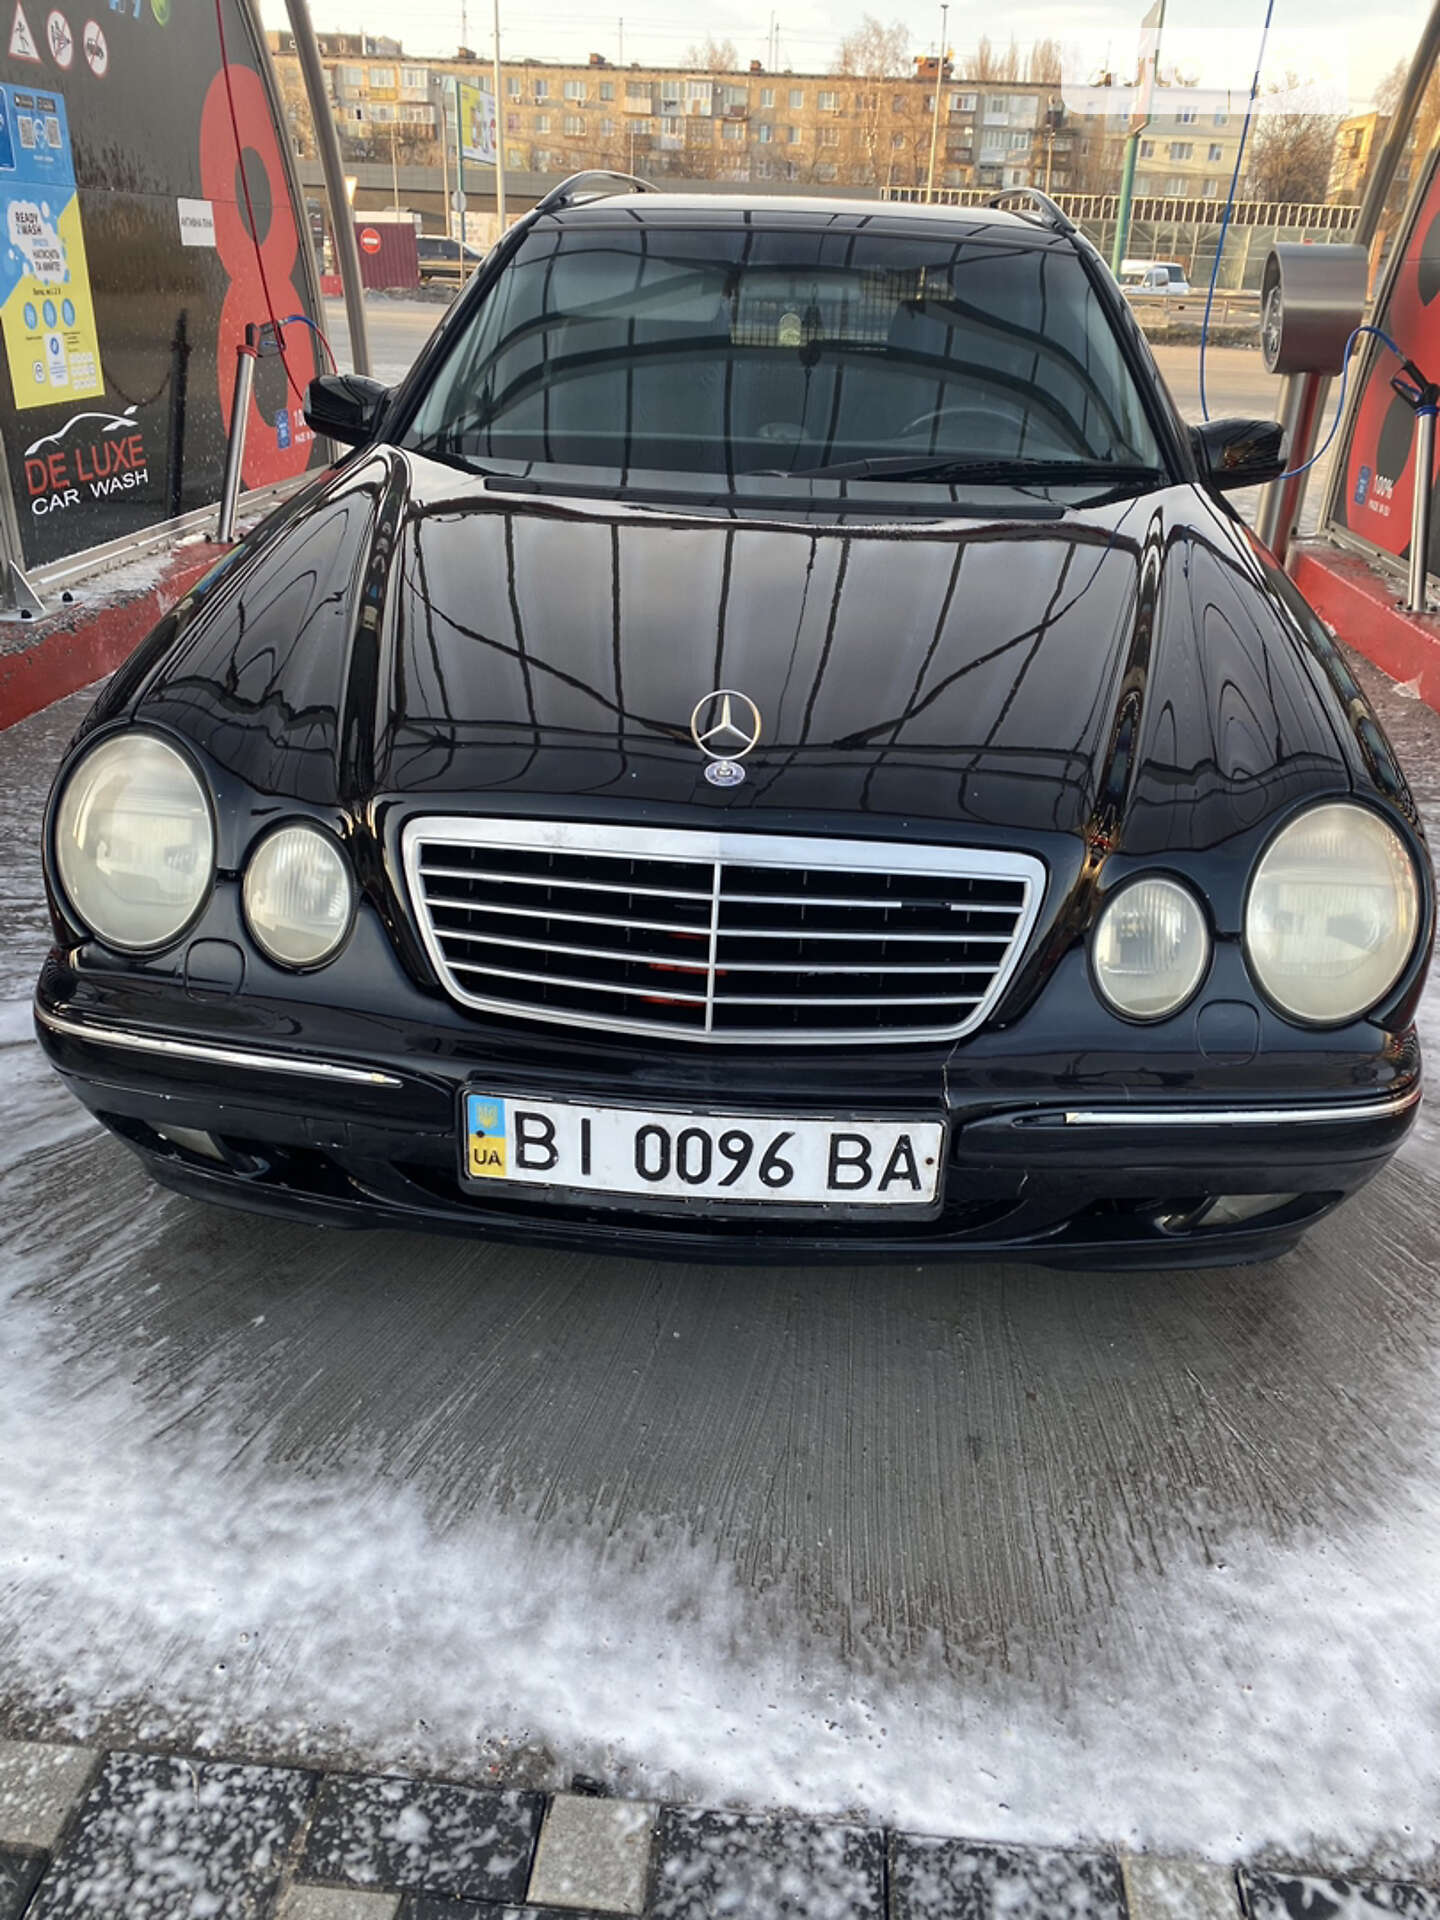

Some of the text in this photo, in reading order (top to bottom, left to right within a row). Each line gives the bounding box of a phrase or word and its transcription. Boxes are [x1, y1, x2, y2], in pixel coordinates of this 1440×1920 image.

[24, 434, 146, 495] DE LUXE
[31, 468, 149, 515] CAR WASH
[473, 1148, 502, 1168] UA
[513, 1110, 922, 1192] BI 0096 BA
